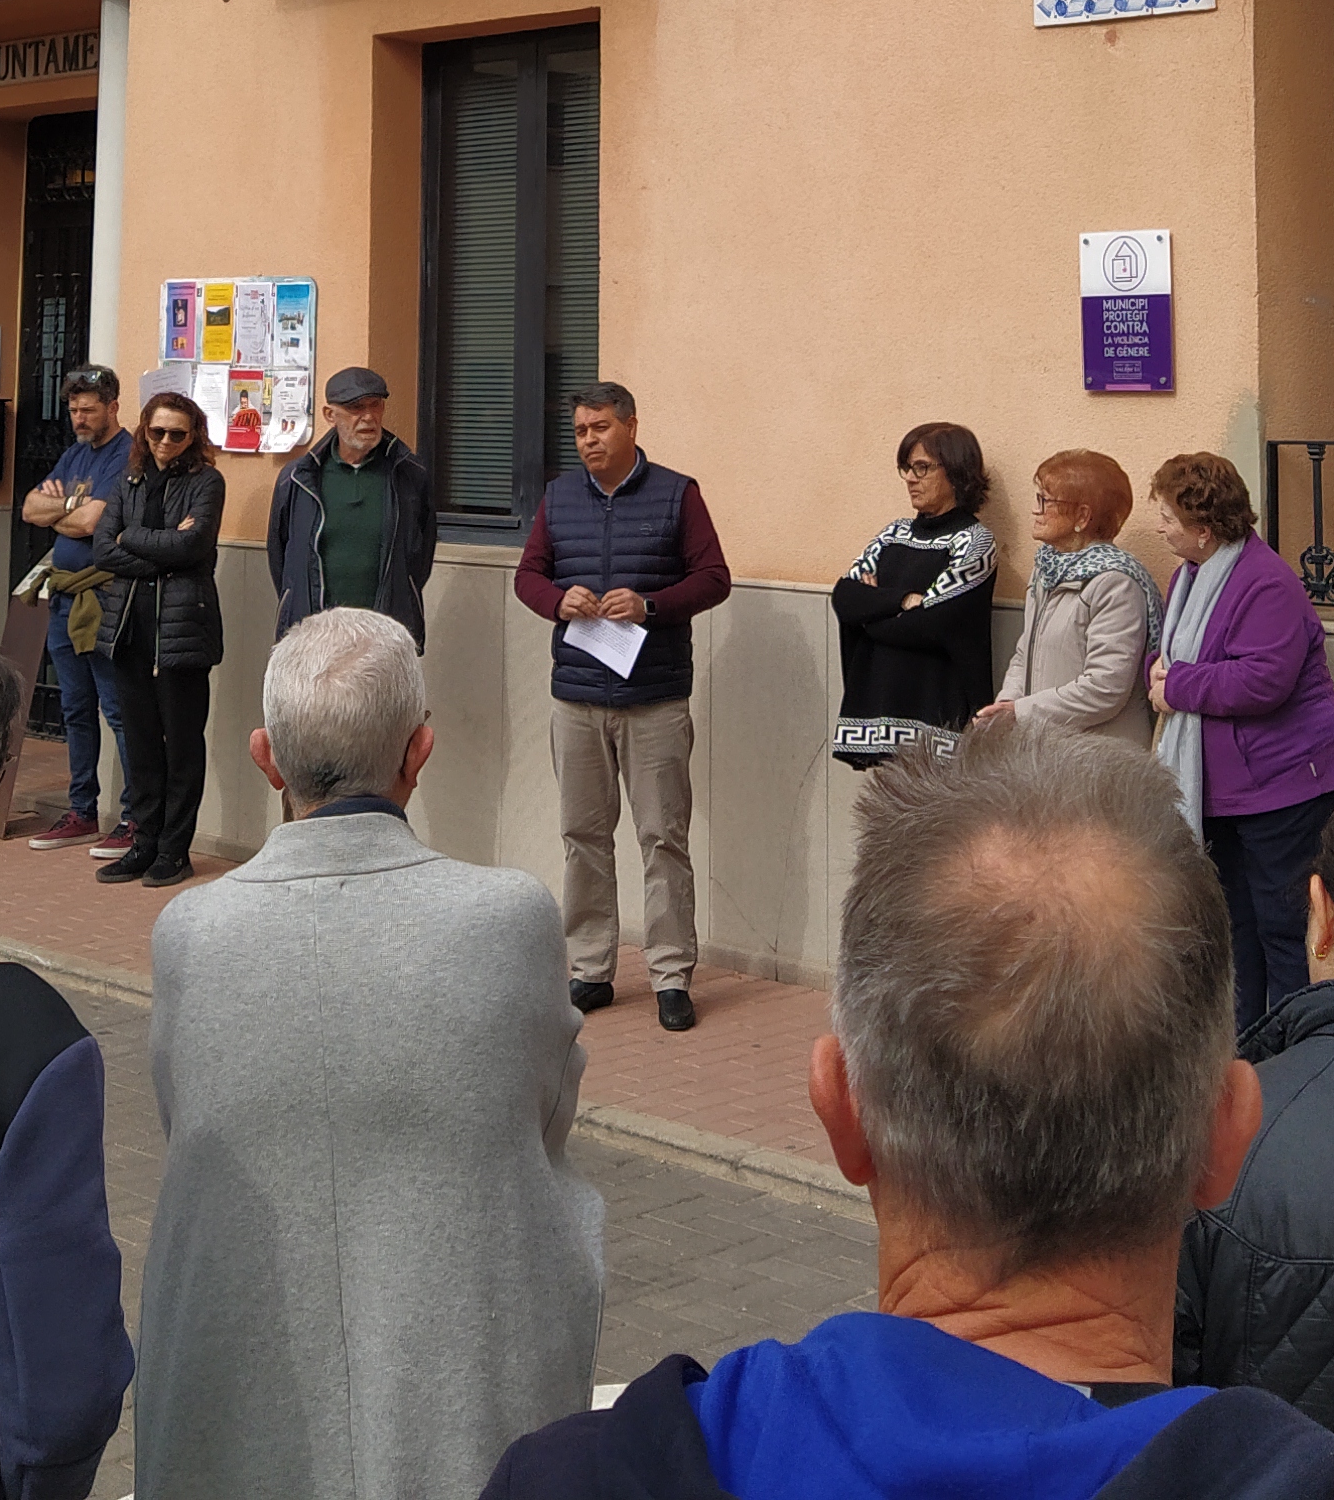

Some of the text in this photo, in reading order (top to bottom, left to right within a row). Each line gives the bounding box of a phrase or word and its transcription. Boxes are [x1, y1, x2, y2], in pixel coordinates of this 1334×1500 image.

[1103, 298, 1148, 310] MUNICIPI
[1103, 311, 1148, 321] PROTEGIT
[1103, 321, 1149, 334] CONTRA
[1103, 336, 1113, 344] LA
[1104, 347, 1115, 357] DE
